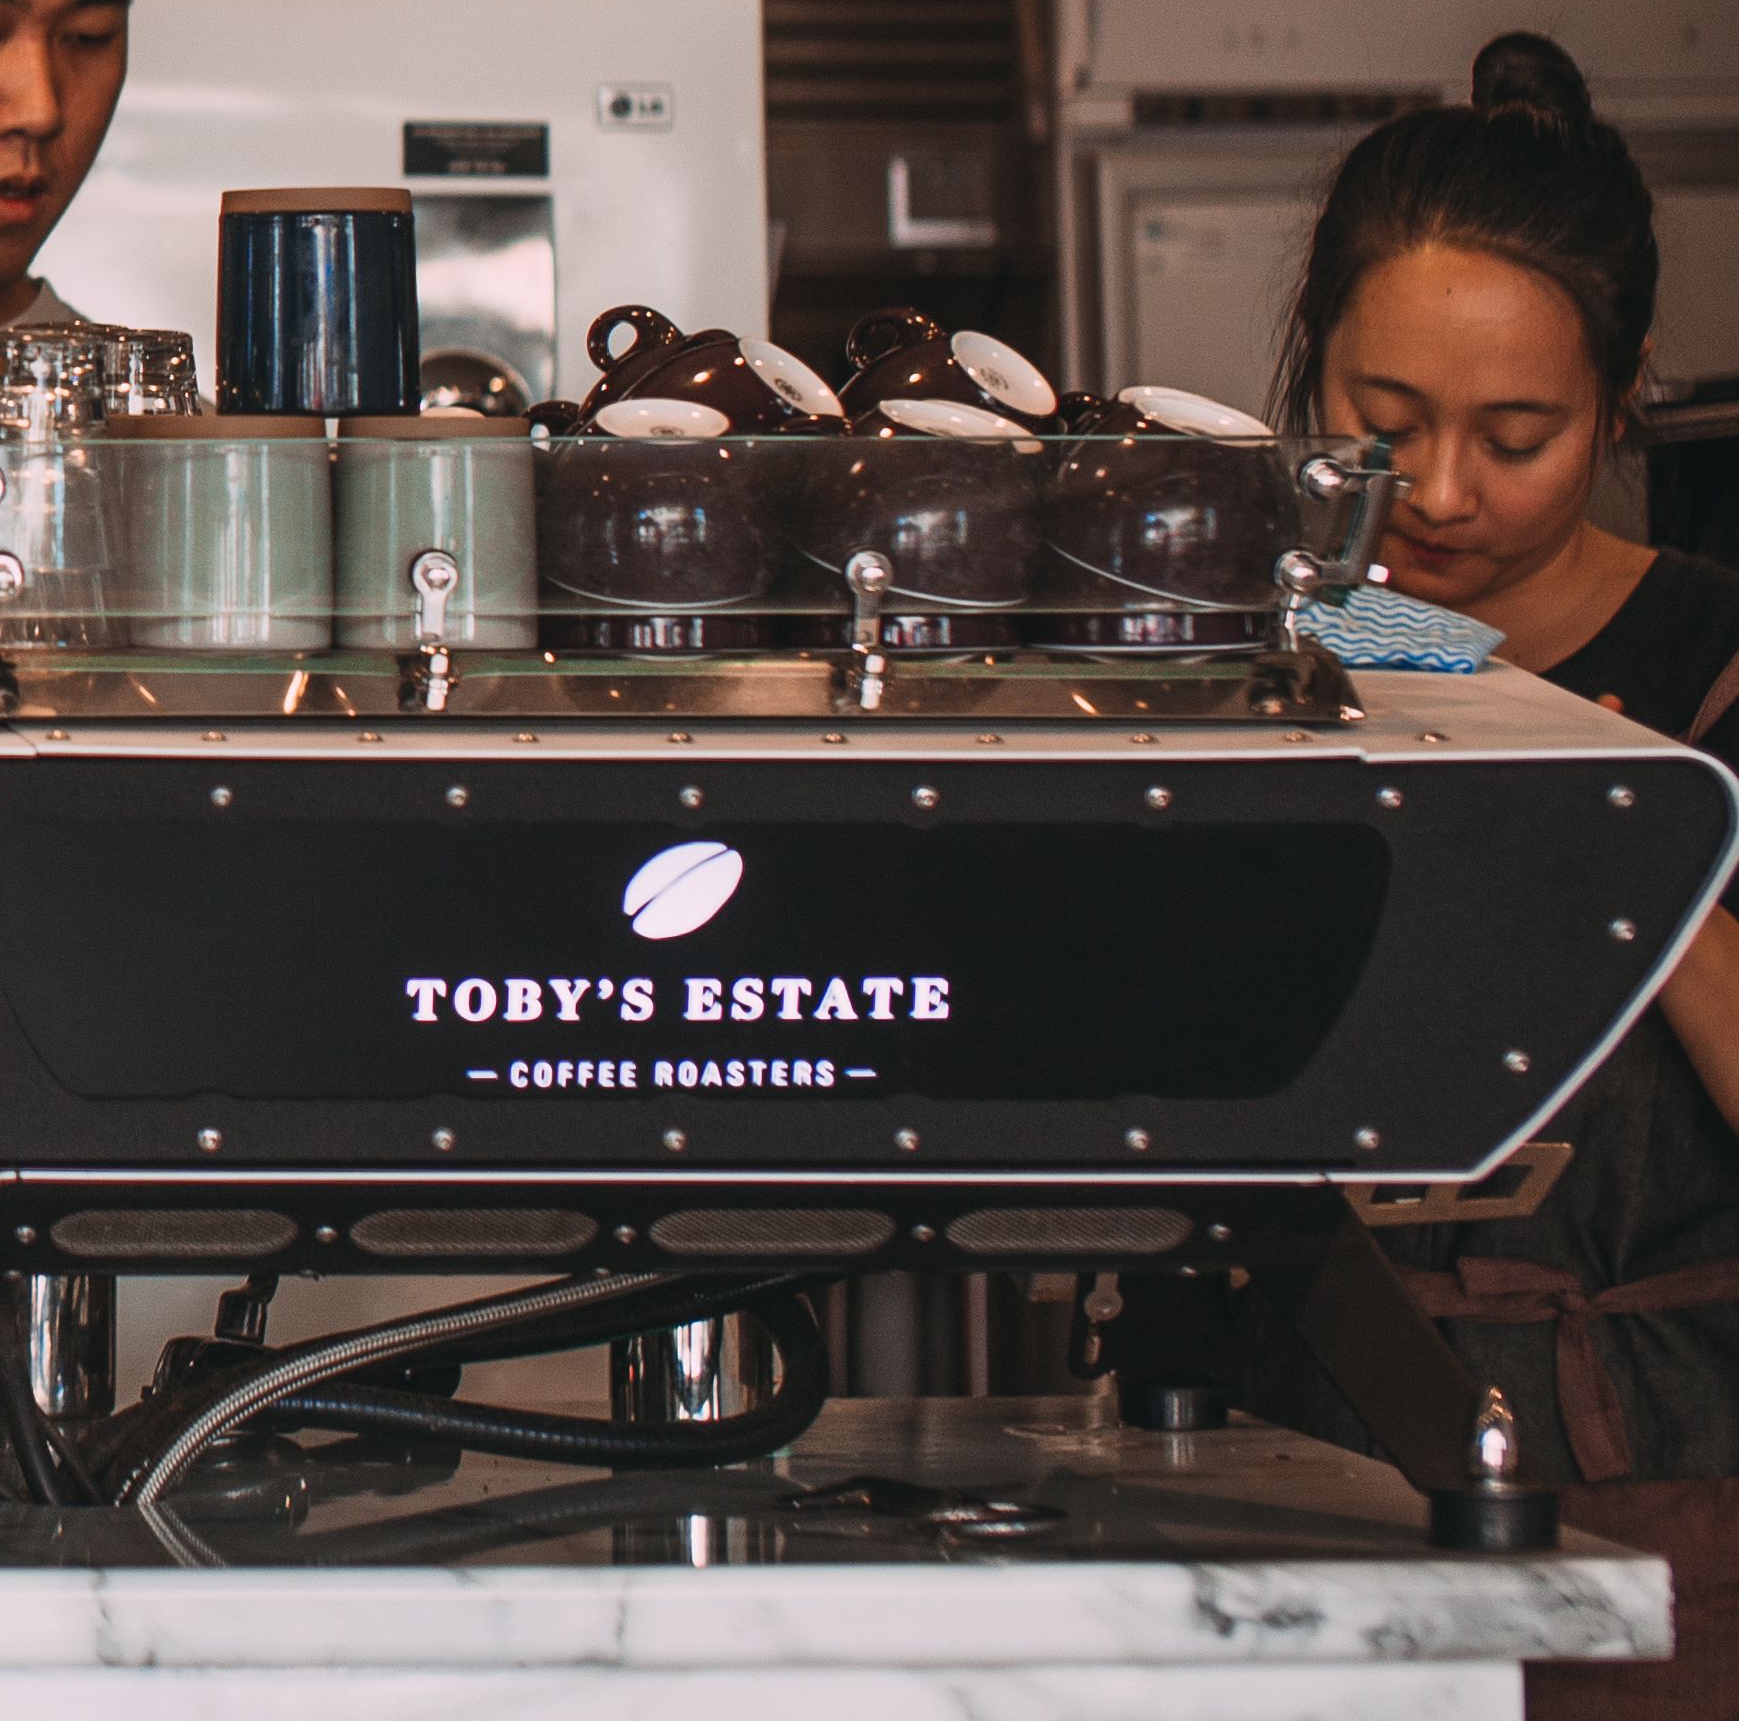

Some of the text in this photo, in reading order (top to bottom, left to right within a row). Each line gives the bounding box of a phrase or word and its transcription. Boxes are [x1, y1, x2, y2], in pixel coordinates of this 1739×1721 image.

[406, 977, 951, 1022] TOBY'S ESTATE
[509, 1060, 836, 1088] COFFEE ROASTERS
